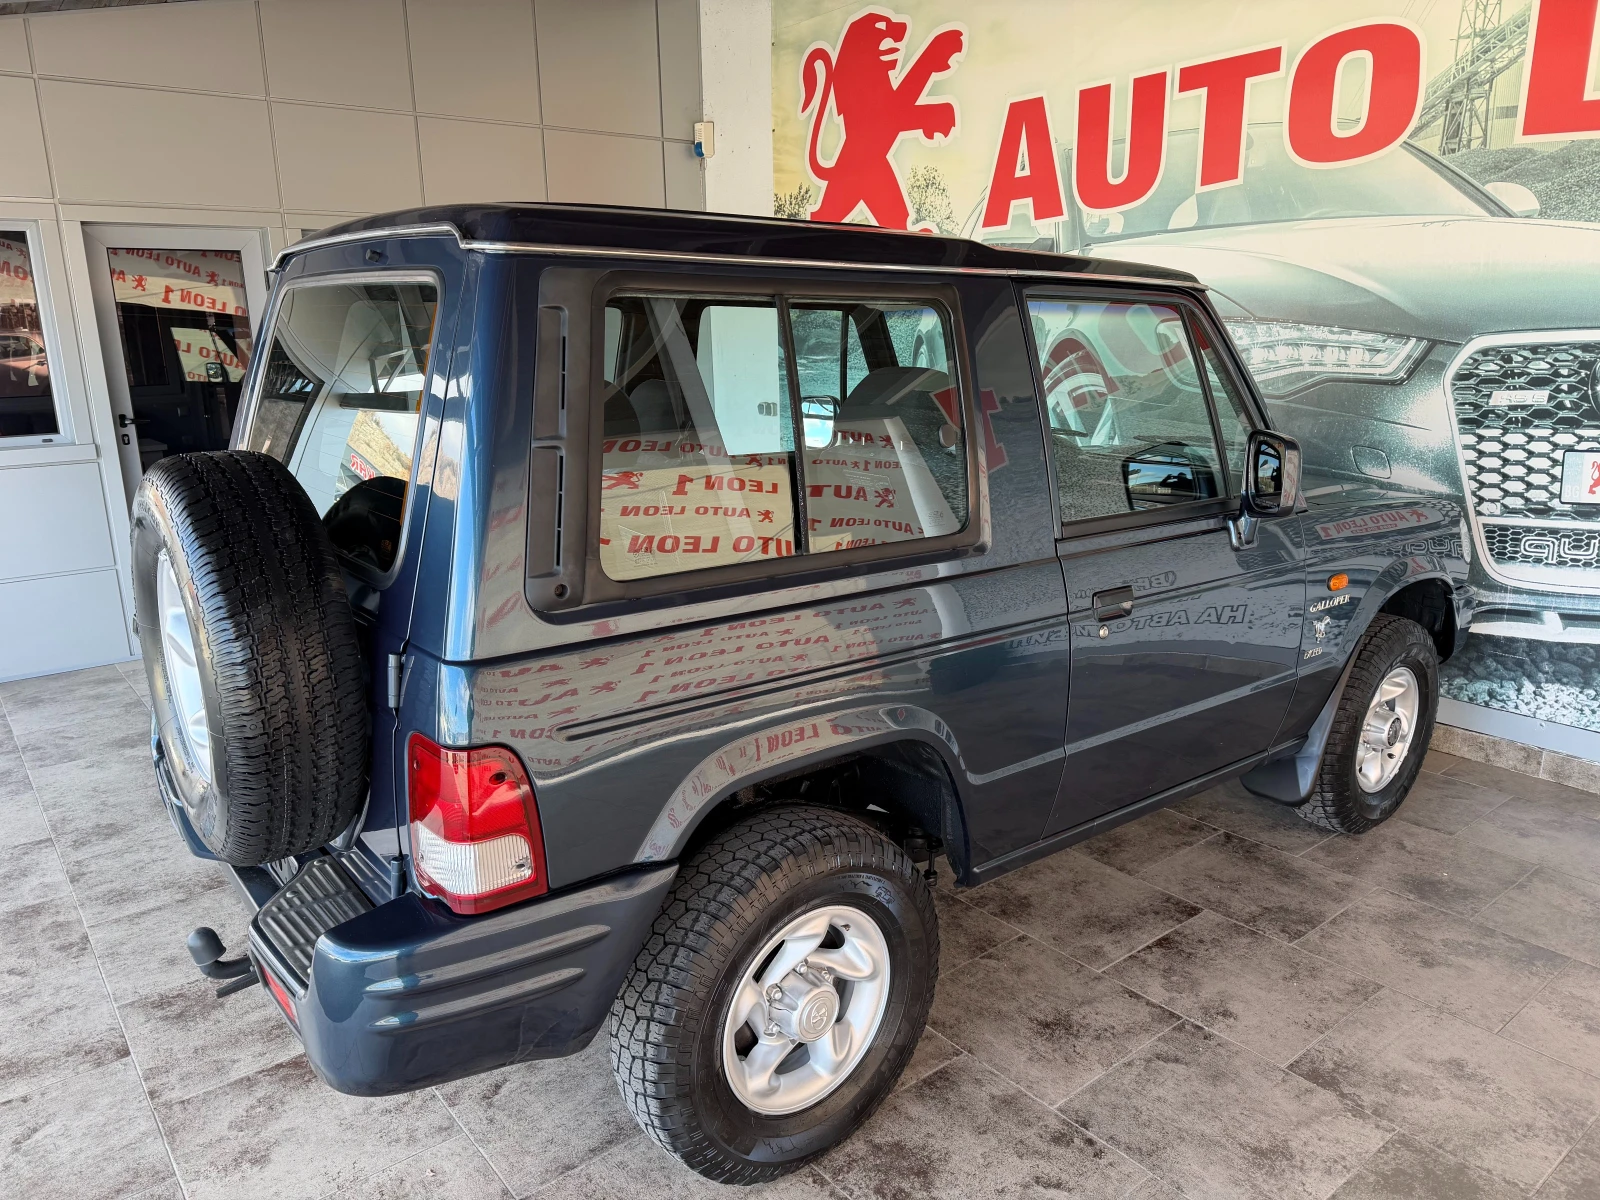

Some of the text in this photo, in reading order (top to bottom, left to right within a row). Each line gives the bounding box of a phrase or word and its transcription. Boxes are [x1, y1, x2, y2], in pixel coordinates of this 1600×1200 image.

[981, 22, 1421, 229] AUTO
[1565, 486, 1580, 498] BG
[1310, 594, 1350, 613] GALLOPER
